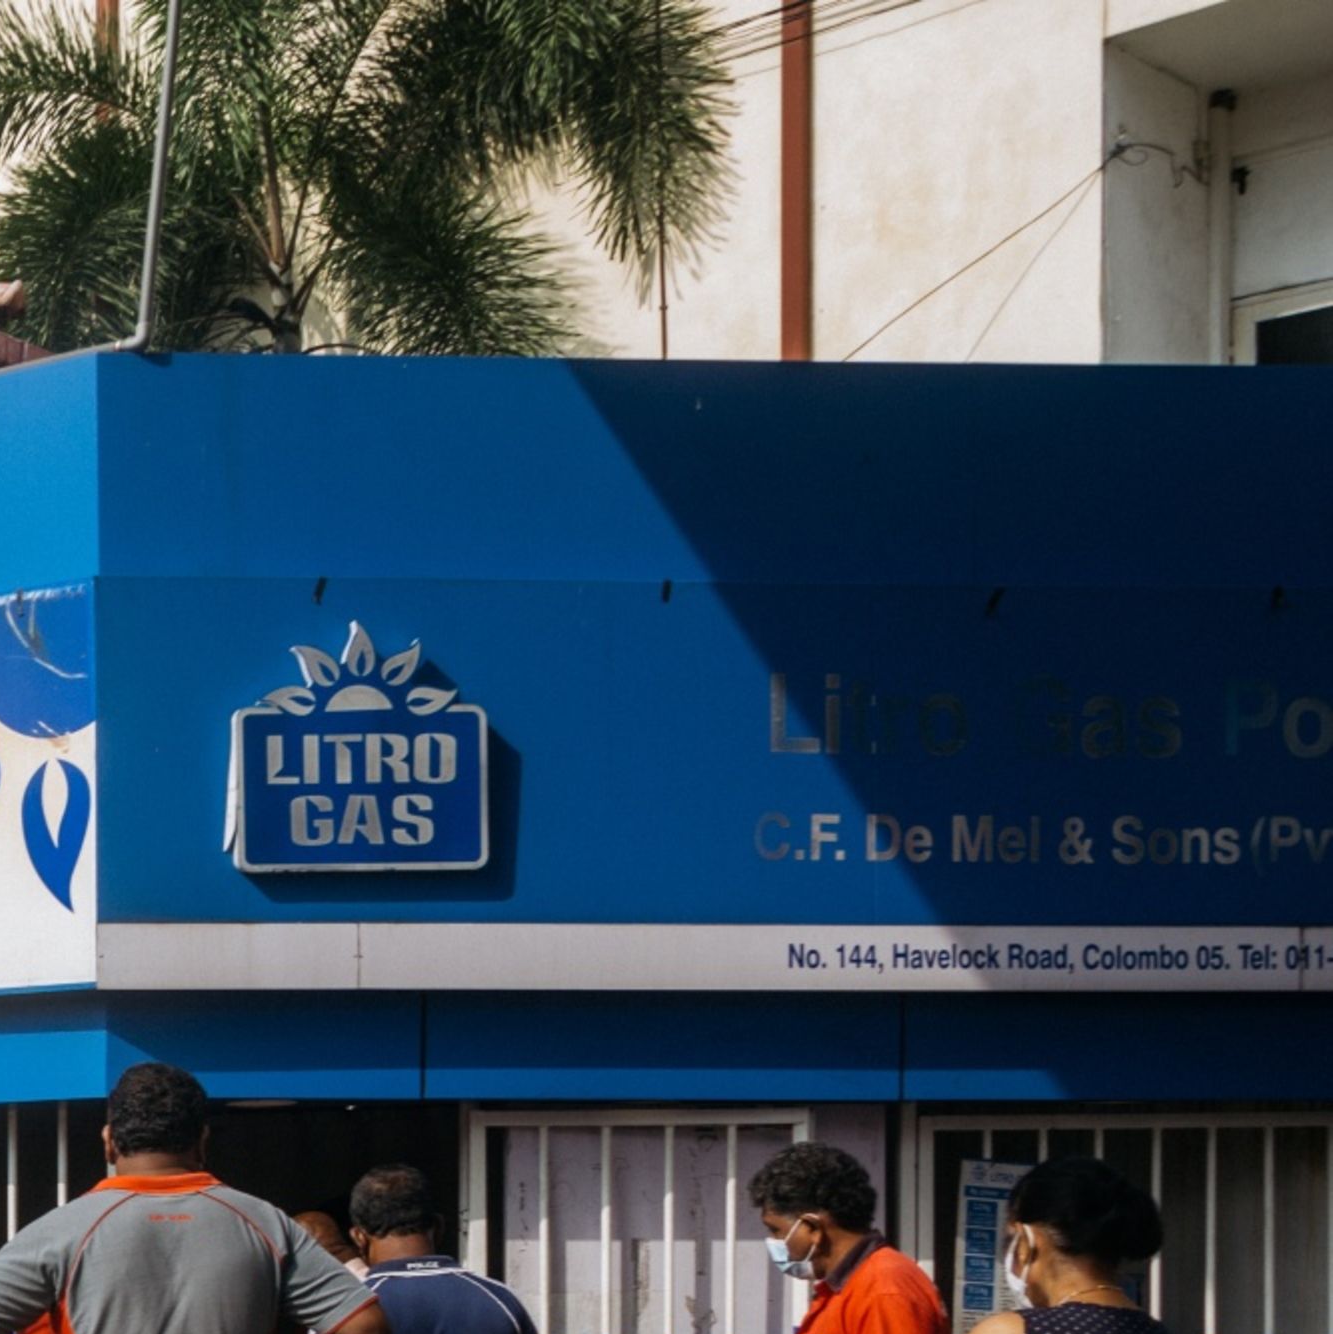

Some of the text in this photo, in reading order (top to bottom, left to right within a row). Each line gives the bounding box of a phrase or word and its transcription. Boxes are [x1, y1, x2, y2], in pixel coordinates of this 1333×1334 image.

[770, 673, 968, 756] Litro
[1013, 673, 1183, 760] Gas
[266, 733, 457, 785] LITRO
[290, 794, 435, 846] GAS
[753, 812, 846, 862] C.F.
[864, 812, 933, 863] De
[951, 812, 1040, 863] Mel
[1058, 816, 1094, 865] &
[1111, 814, 1241, 865] Sons
[787, 943, 827, 969] No.
[836, 943, 885, 974] 144,
[892, 943, 1001, 969] Havelock
[1008, 943, 1075, 974] Road,
[1082, 943, 1189, 970] Colombo
[1196, 944, 1230, 970] 05.
[1238, 944, 1277, 970] Tel:
